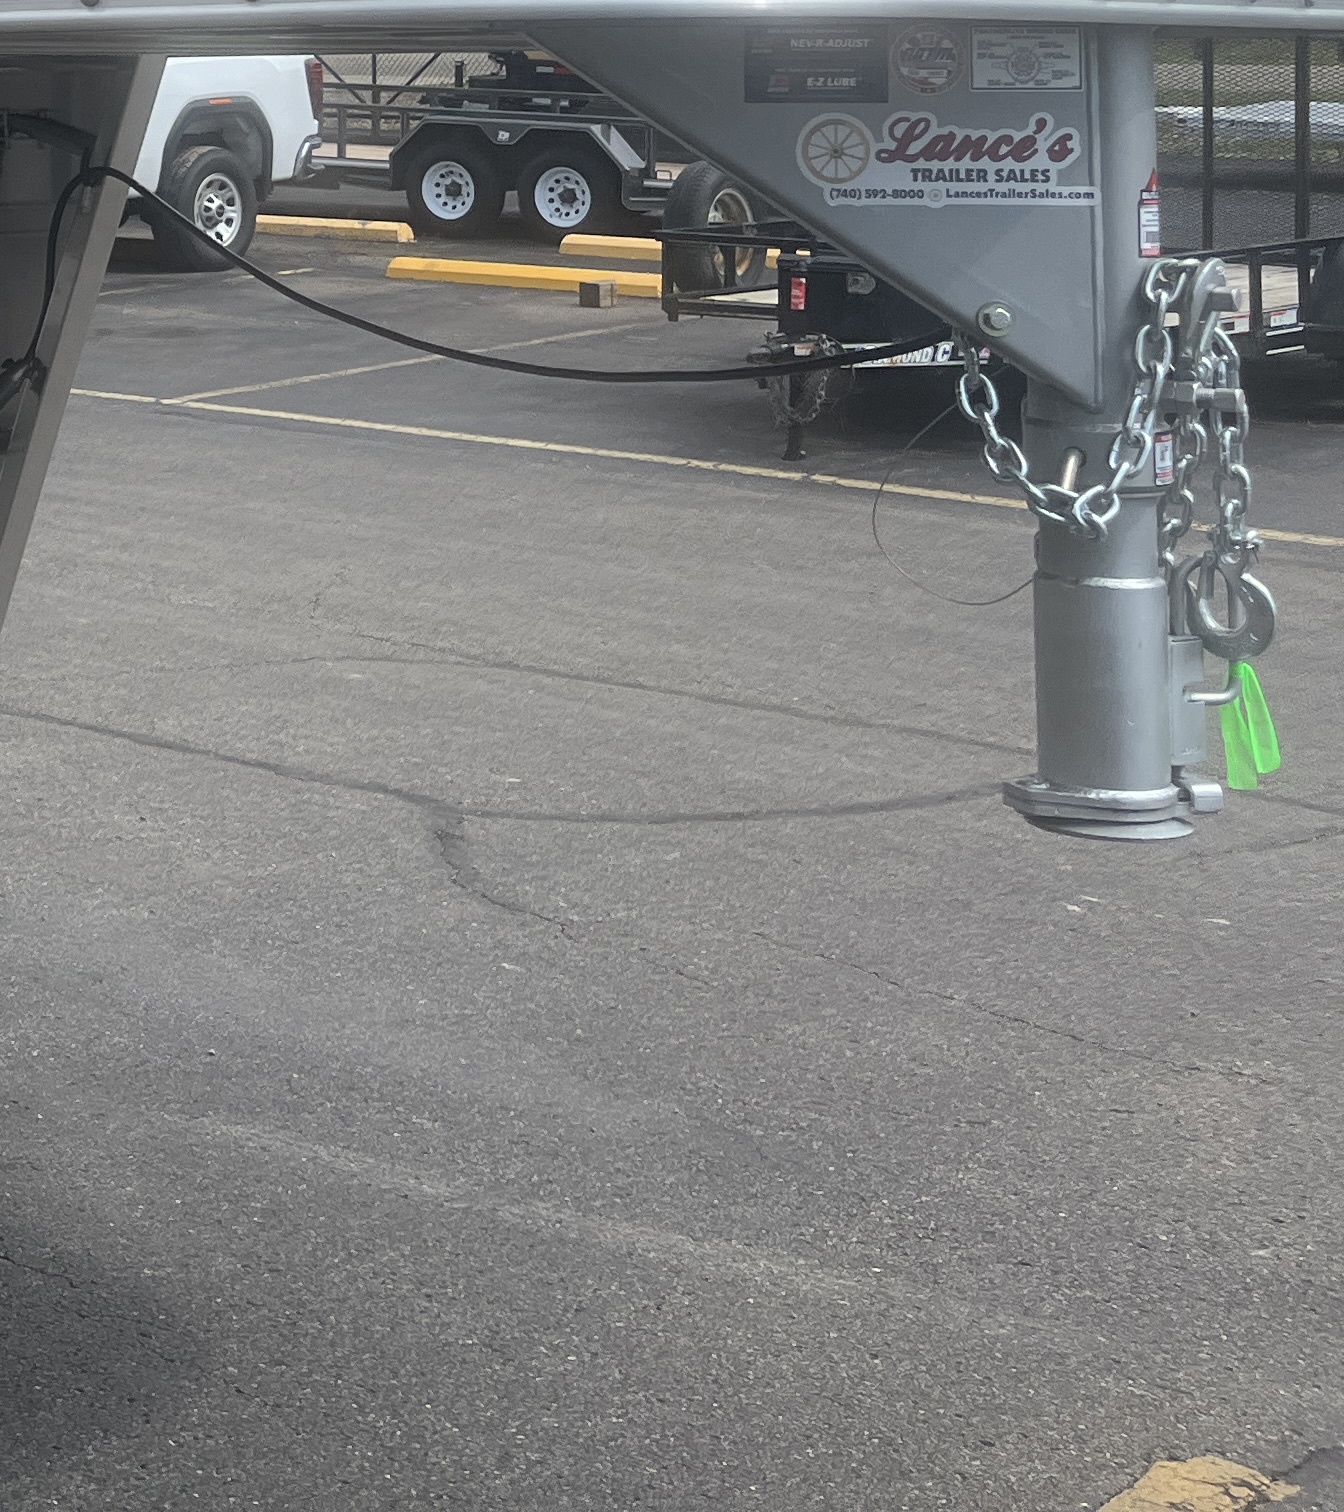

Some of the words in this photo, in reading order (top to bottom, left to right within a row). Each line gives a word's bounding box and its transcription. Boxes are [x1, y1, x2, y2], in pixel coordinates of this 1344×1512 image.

[790, 38, 870, 48] NEV-R-ADJUST
[806, 77, 824, 87] E-Z
[827, 77, 857, 87] LUBE
[875, 116, 1074, 163] Lance's
[910, 168, 988, 183] TRAILER
[994, 168, 1051, 183] SALES
[829, 188, 862, 200] (740)
[945, 188, 1095, 200] LancesTrailerSales.com
[936, 343, 952, 364] C
